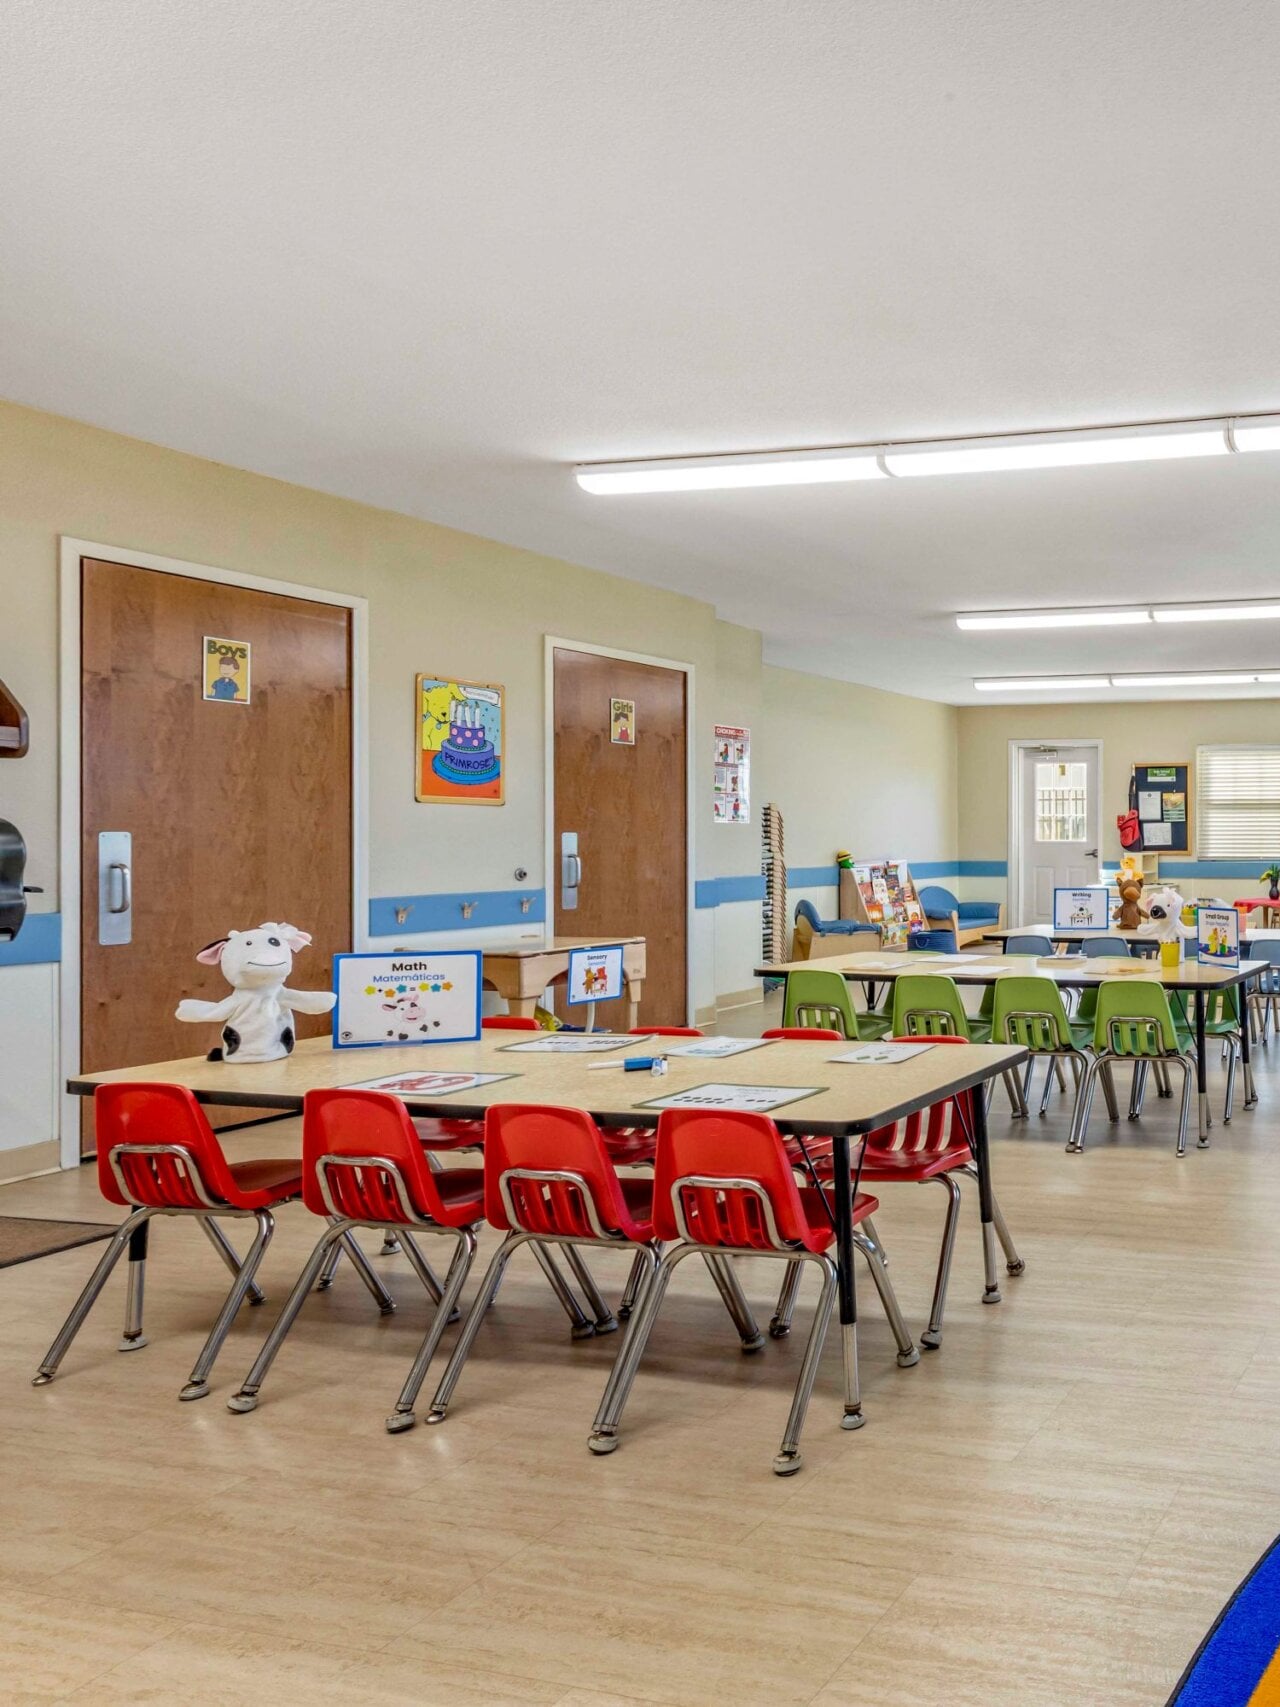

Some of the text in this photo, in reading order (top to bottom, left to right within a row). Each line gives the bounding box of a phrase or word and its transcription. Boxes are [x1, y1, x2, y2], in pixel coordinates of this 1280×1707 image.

[207, 640, 247, 659] Boys
[613, 700, 633, 713] Girls
[444, 752, 493, 770] PRIMROSE
[392, 962, 427, 972] Math
[373, 973, 445, 983] Matemáticas
